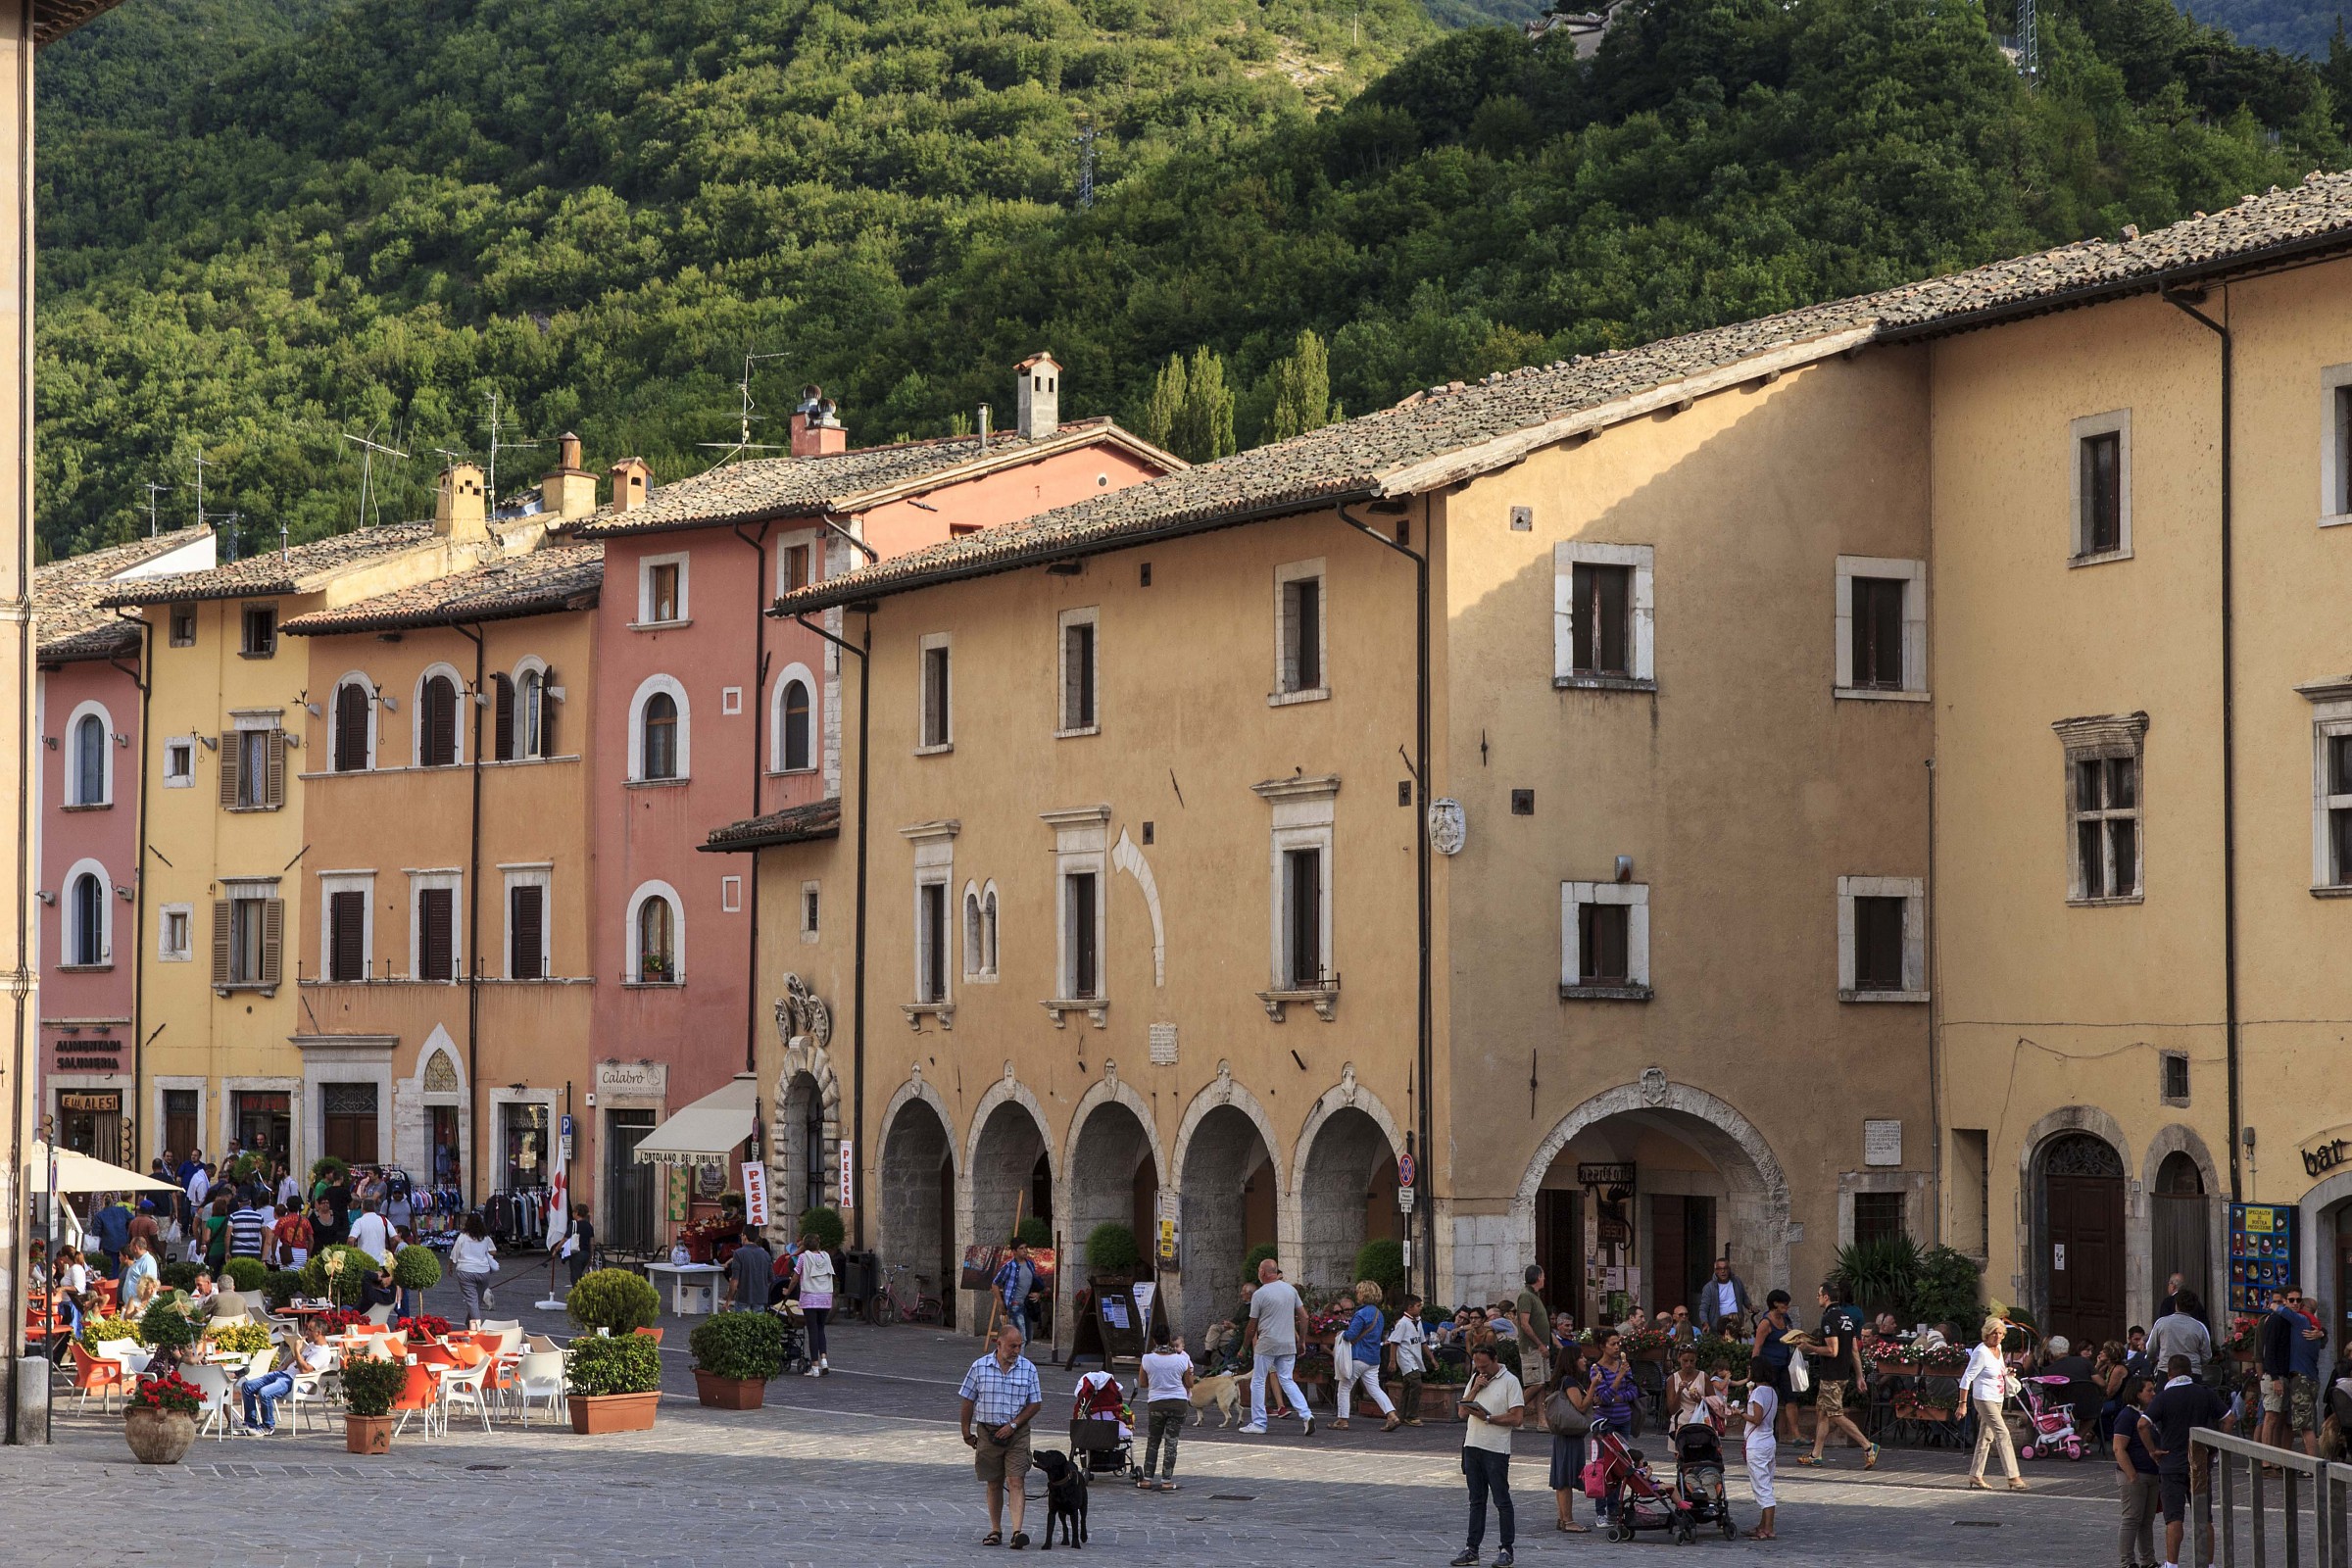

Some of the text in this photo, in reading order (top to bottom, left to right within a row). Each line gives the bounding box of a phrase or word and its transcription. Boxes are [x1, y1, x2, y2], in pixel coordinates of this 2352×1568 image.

[55, 1040, 122, 1052] ALIMENTARI
[56, 1057, 120, 1069] SALUMERIA
[602, 1070, 646, 1084] Calabrò
[84, 1097, 117, 1109] ALESI
[563, 1117, 570, 1134] P
[681, 1153, 691, 1163] DEI
[2300, 1138, 2349, 1177] bar
[748, 1170, 764, 1225] PESCA
[1598, 1225, 1624, 1238] VISSO
